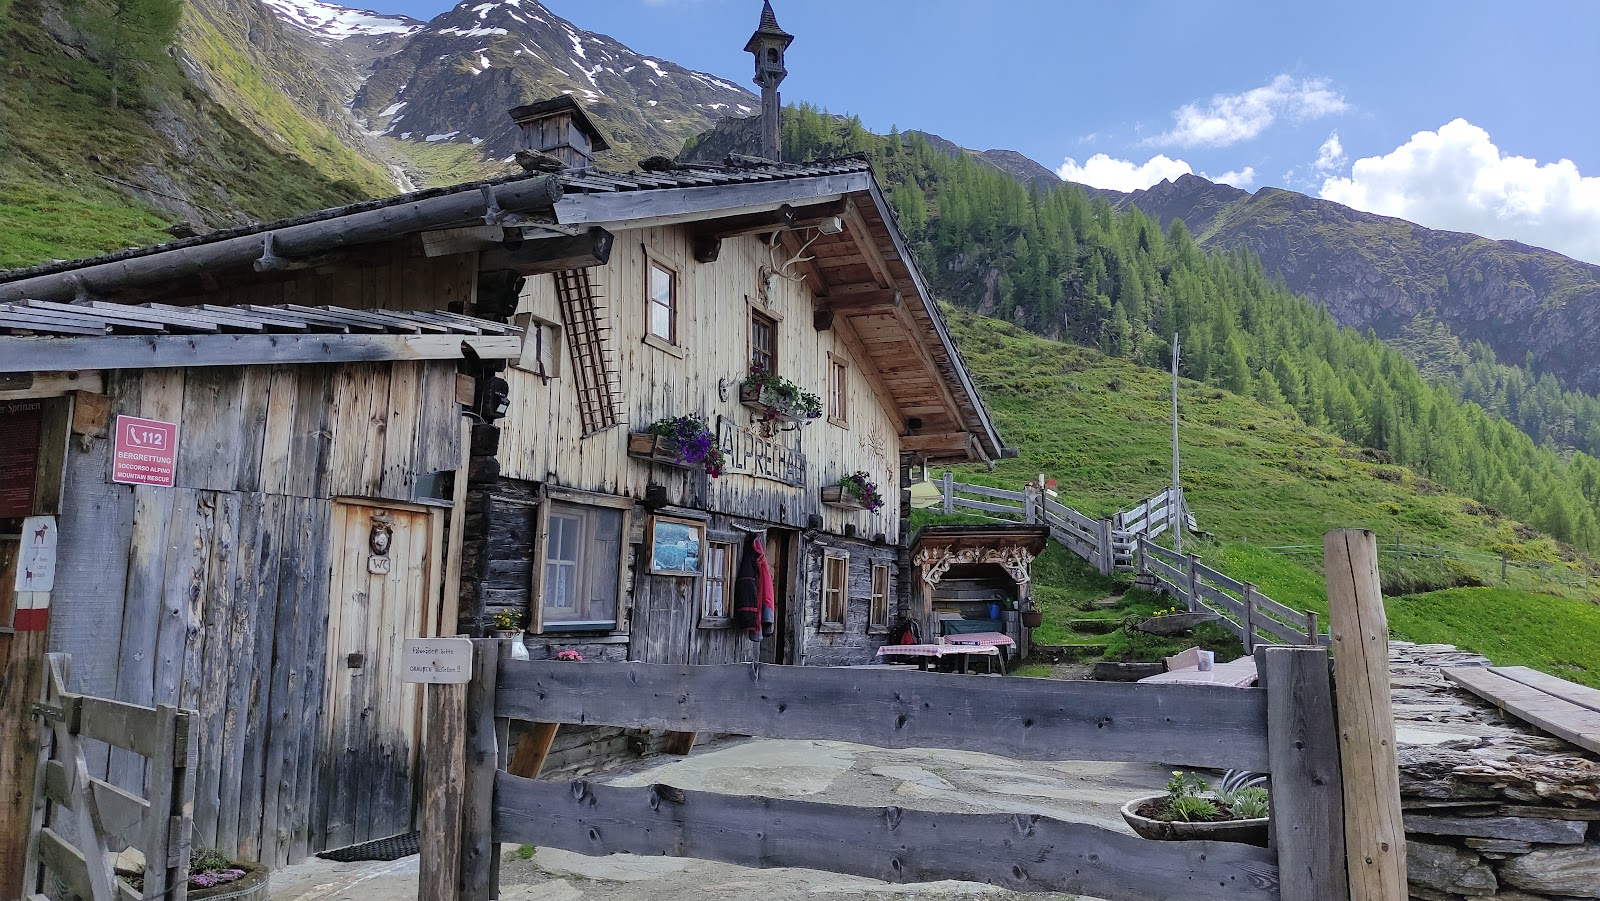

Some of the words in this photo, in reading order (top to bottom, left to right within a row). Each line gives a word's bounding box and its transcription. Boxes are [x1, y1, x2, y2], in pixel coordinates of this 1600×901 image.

[142, 431, 163, 445] 112
[118, 451, 172, 464] BERGRETTUNG
[118, 462, 150, 472] SOCCORSO
[149, 466, 171, 474] ALPINO
[117, 471, 147, 480] MOUNTAIN
[146, 475, 170, 483] RESCUE
[373, 558, 388, 571] WC
